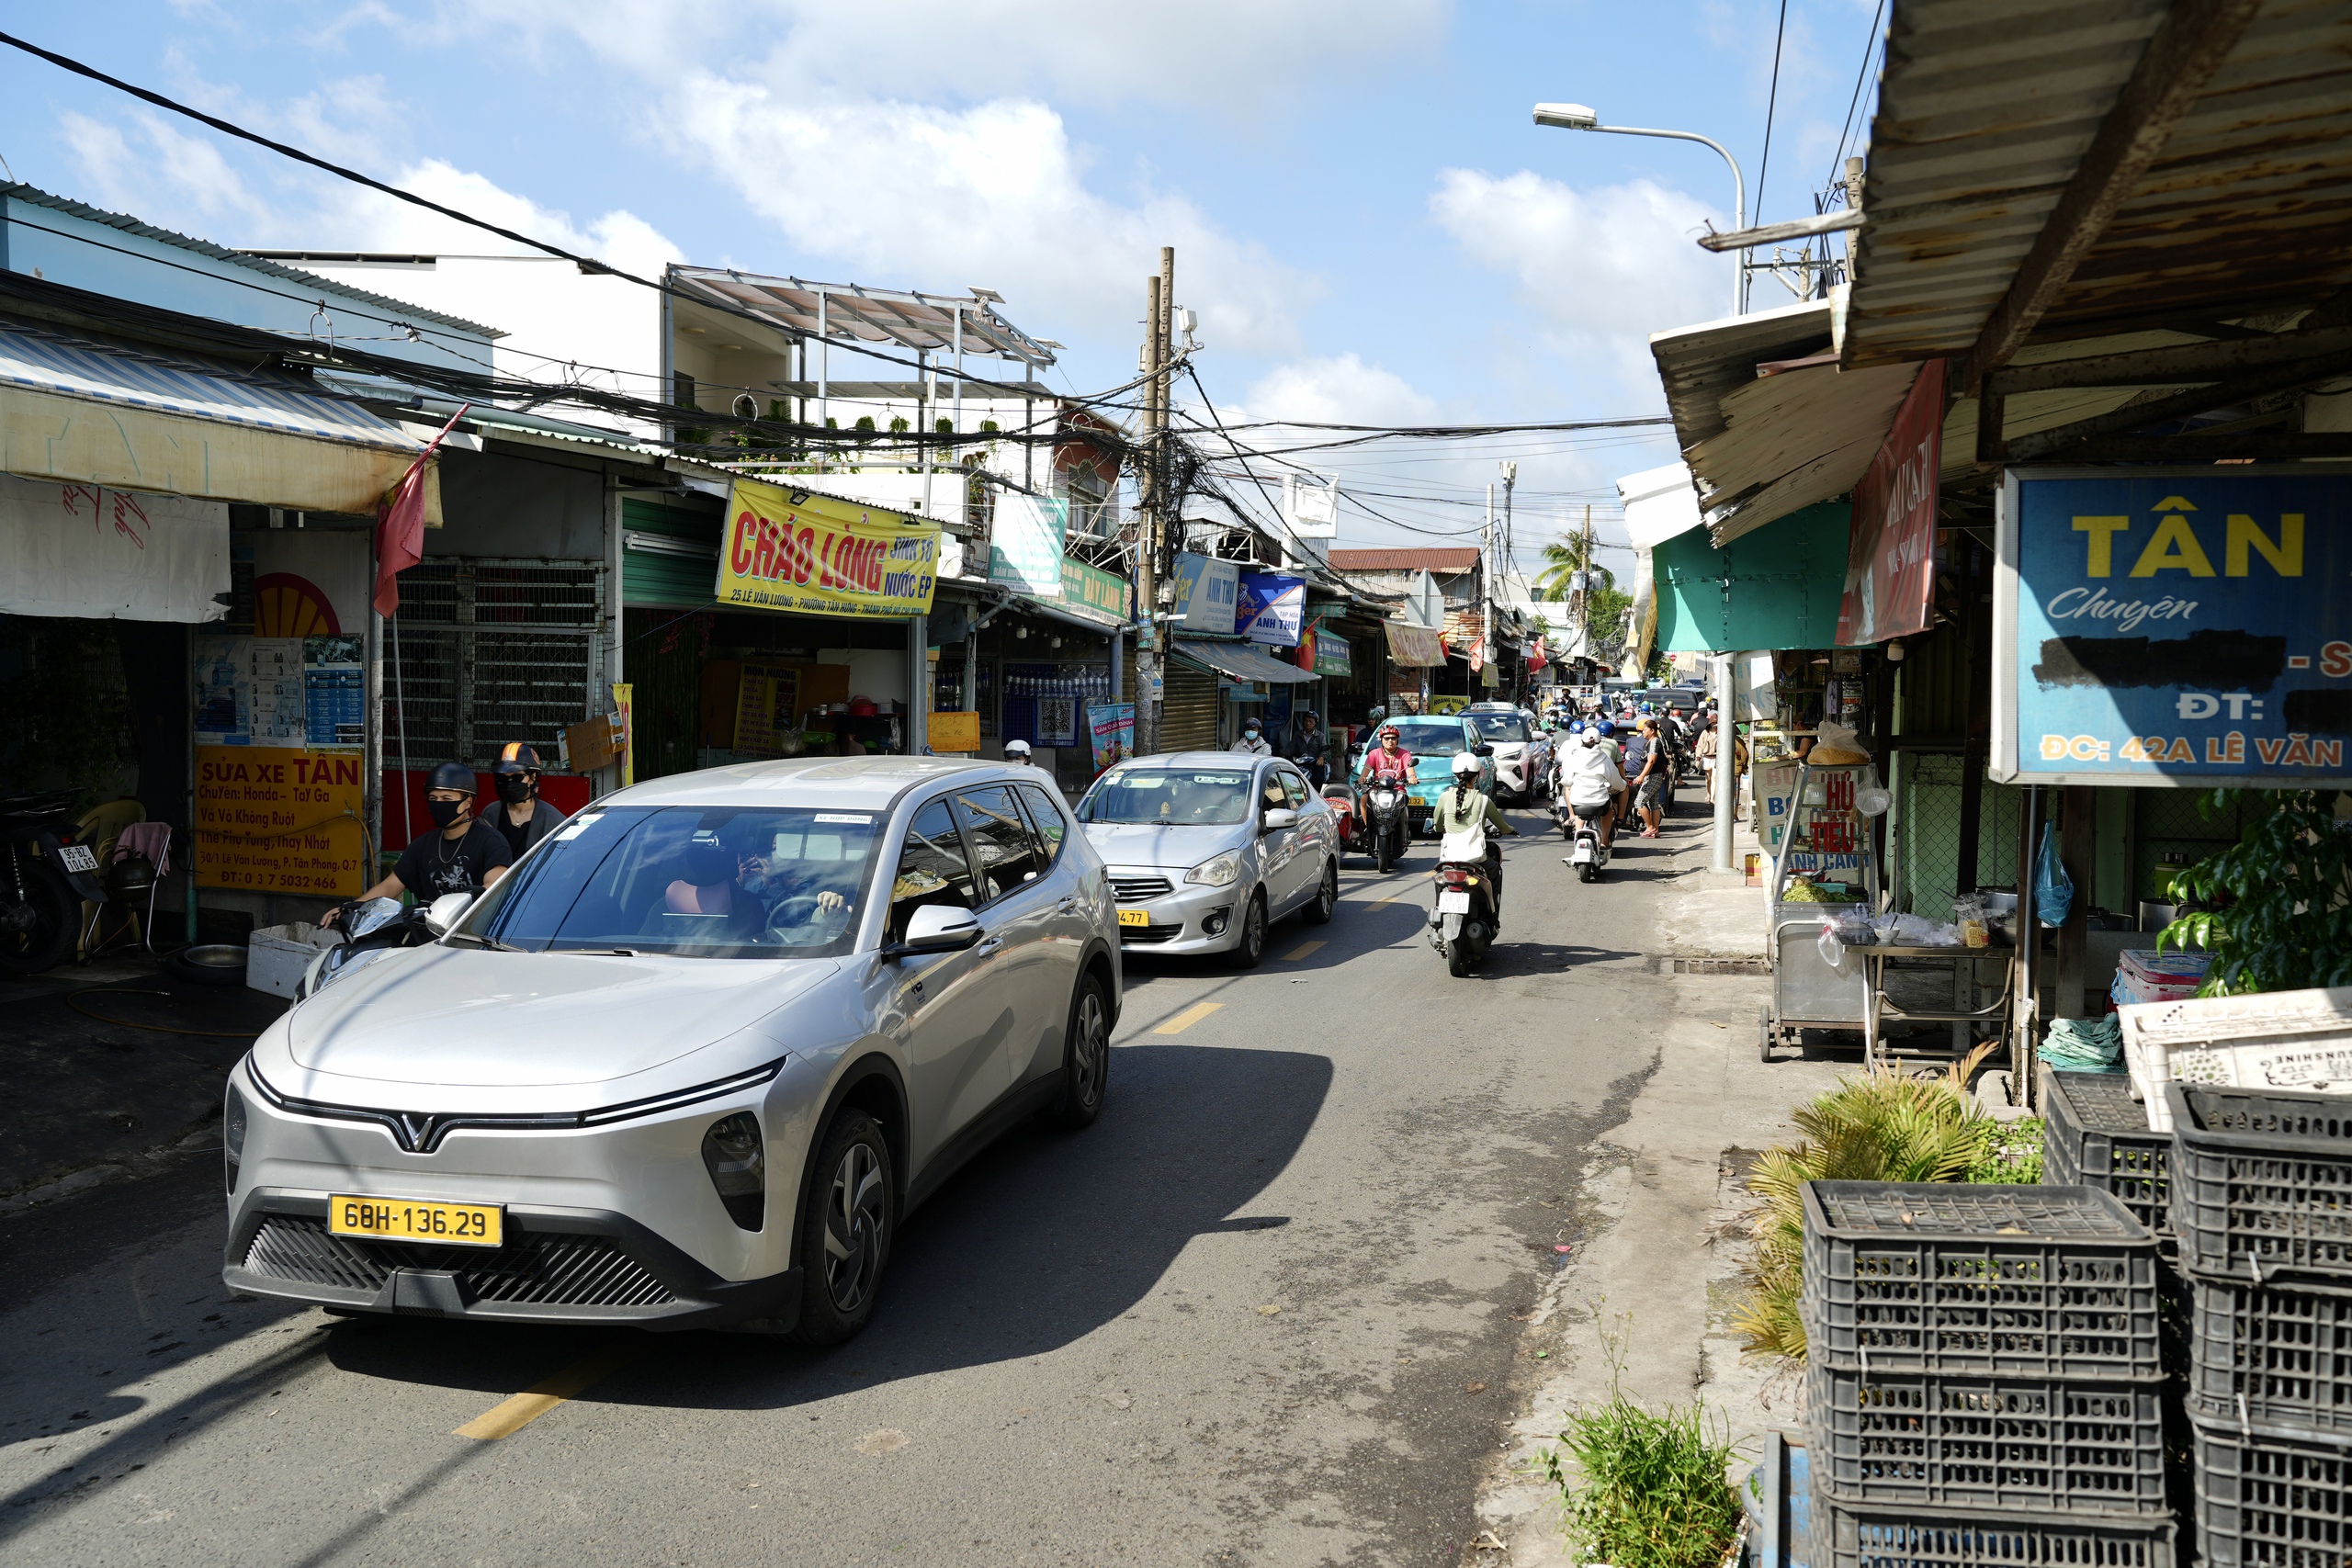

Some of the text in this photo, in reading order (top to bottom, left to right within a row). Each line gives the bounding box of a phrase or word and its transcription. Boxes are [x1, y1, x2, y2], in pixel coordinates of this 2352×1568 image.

[889, 532, 935, 563] SINH TỐ
[2072, 495, 2305, 579] TÂN
[731, 511, 888, 595] CHÁO LÒNG
[883, 568, 932, 599] NƯỚC ÉP
[1206, 576, 1236, 605] ANH THƯ
[730, 589, 741, 601] 25
[742, 589, 753, 602] LÊ
[753, 591, 769, 604] VĂN
[770, 592, 794, 608] LƯƠNG
[798, 598, 826, 612] PHƯỜNG
[826, 598, 840, 613] TÂN
[841, 602, 857, 614] HƯNG
[861, 603, 880, 615] THÀNH
[879, 603, 894, 615] PHỐ
[1237, 603, 1258, 620] ger
[2047, 586, 2199, 632] Chuyên
[1256, 617, 1298, 631] ANH THƯ
[2320, 641, 2352, 677] S
[766, 667, 796, 680] NƯỚNG
[2176, 694, 2264, 720] ĐT:
[2039, 730, 2343, 768] ĐC: 42A LÊ VĂN
[201, 753, 358, 785] SỬA XE TÂN
[243, 785, 277, 801] Honda
[314, 787, 330, 803] Ga
[1827, 771, 1854, 811] HỦ
[200, 807, 215, 822] Vá
[235, 808, 268, 829] Không
[272, 811, 295, 828] Ruột
[304, 835, 331, 851] Nhớt
[67, 858, 96, 871] 104.85
[222, 852, 232, 864] Lê
[233, 853, 250, 865] Văn
[252, 855, 281, 870] Lương,
[283, 857, 291, 868] P.
[293, 857, 309, 868] Tân
[311, 858, 341, 873] Phong,
[342, 860, 357, 871] Q.7
[1117, 913, 1142, 923] 4.77
[345, 1202, 486, 1237] 68H-136.29
